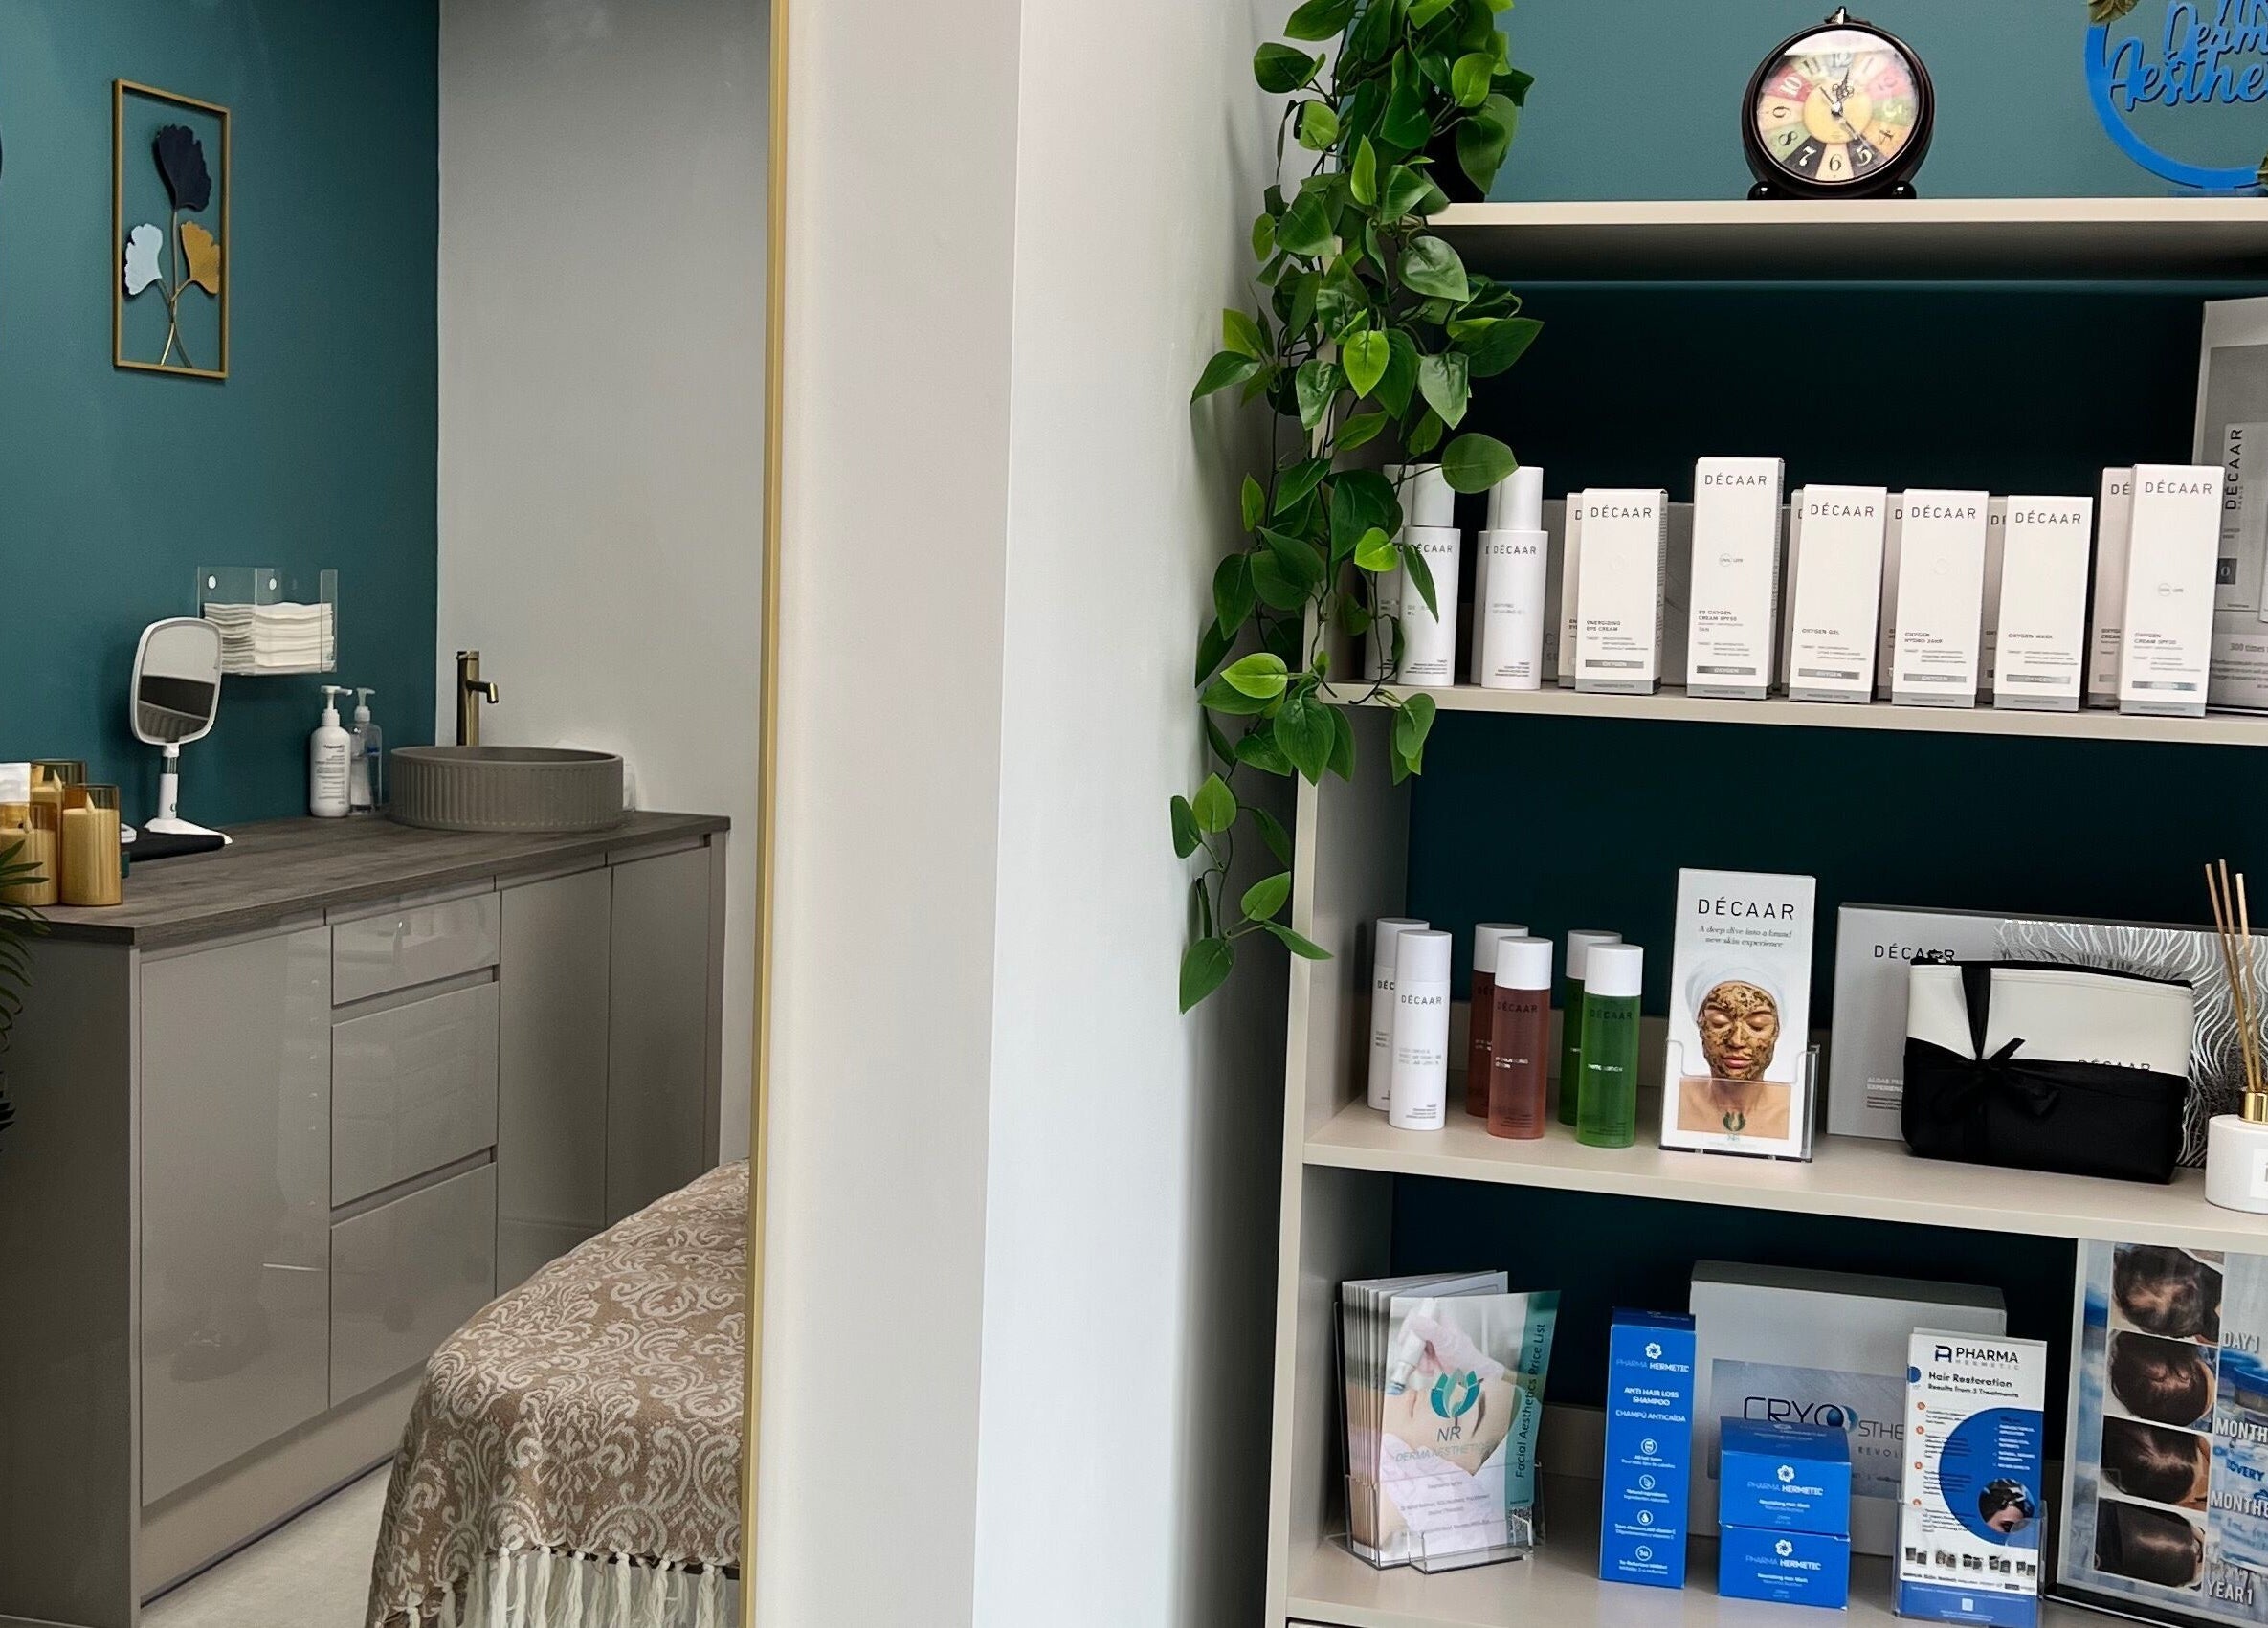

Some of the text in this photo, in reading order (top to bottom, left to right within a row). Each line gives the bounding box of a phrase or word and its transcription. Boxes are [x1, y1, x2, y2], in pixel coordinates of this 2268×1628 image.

[1832, 52, 1851, 68] 12
[1779, 76, 1803, 97] 10
[1778, 130, 1799, 146] 8
[1798, 145, 1817, 167] 7
[1828, 153, 1842, 171] 6
[1855, 145, 1874, 167] 5
[1704, 472, 1768, 486] DÉCAAR
[2146, 479, 2212, 495] DÉCAAR
[1590, 504, 1652, 519] DÉCAAR
[1811, 502, 1874, 517] DÉCAAR
[1911, 505, 1976, 519] DÉCAAR
[2015, 510, 2082, 524] DÉCAAR
[1493, 544, 1537, 555] DÉCAAR
[1698, 897, 1794, 920] DÉCAAR
[1401, 994, 1442, 1005] DÉCAAR
[2222, 1331, 2251, 1351] DAY
[1956, 1347, 2019, 1363] PHARMA
[1649, 1362, 1690, 1372] HERMETIC
[1928, 1372, 2012, 1388] Hair Restoration
[1623, 1387, 1642, 1395] ANTI
[1661, 1390, 1679, 1398] LOSS
[1927, 1383, 1953, 1393] Results
[1954, 1386, 1972, 1394] from
[1515, 1324, 1546, 1479] Facial Aesthetics Price List
[1633, 1396, 1670, 1406] SHAMPOO
[1437, 1426, 1461, 1442] NR
[1782, 1484, 1824, 1496] HERMETIC
[1779, 1559, 1822, 1571] HERMETIC
[2206, 1577, 2254, 1606] YEAR 1
